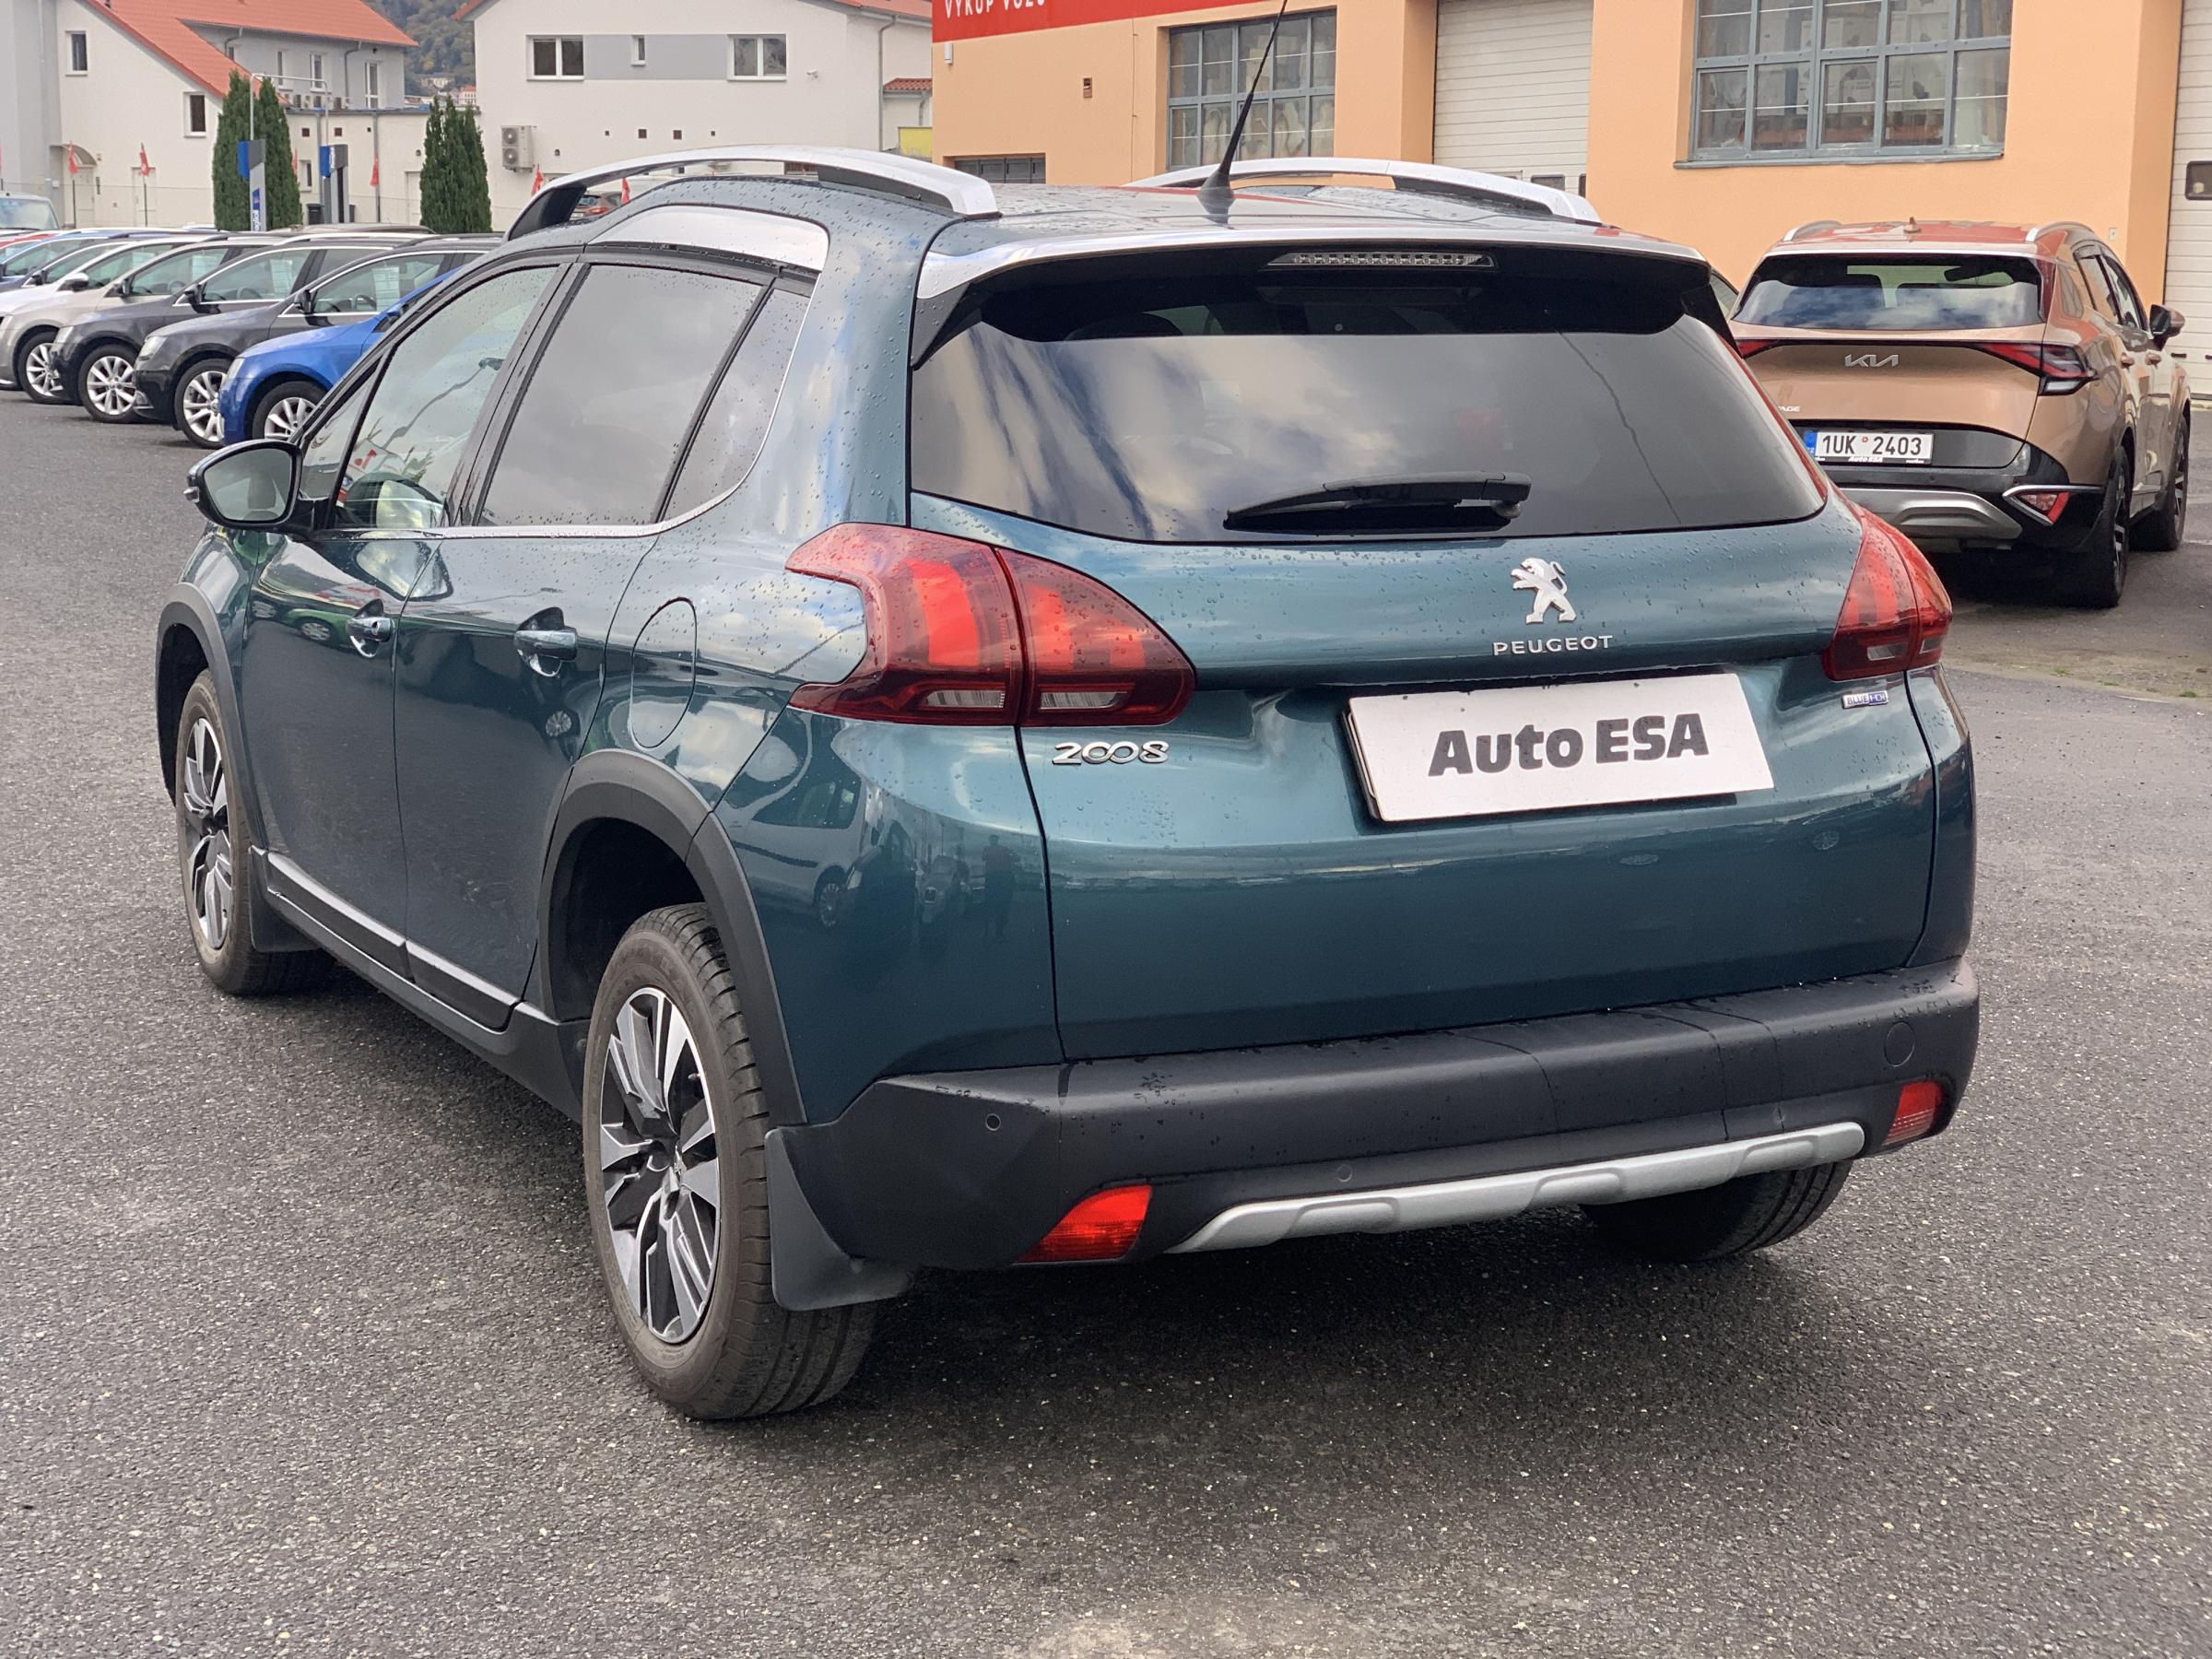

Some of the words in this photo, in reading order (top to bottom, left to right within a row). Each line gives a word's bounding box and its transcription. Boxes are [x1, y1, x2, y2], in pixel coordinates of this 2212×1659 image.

[945, 0, 994, 18] VYKUP
[1823, 435, 1856, 454] 1UK
[1872, 436, 1922, 455] 2403
[1492, 635, 1613, 656] PEUGEOT
[1052, 740, 1170, 765] 2008
[1428, 728, 1584, 776] Auto
[1595, 713, 1710, 764] ESA
